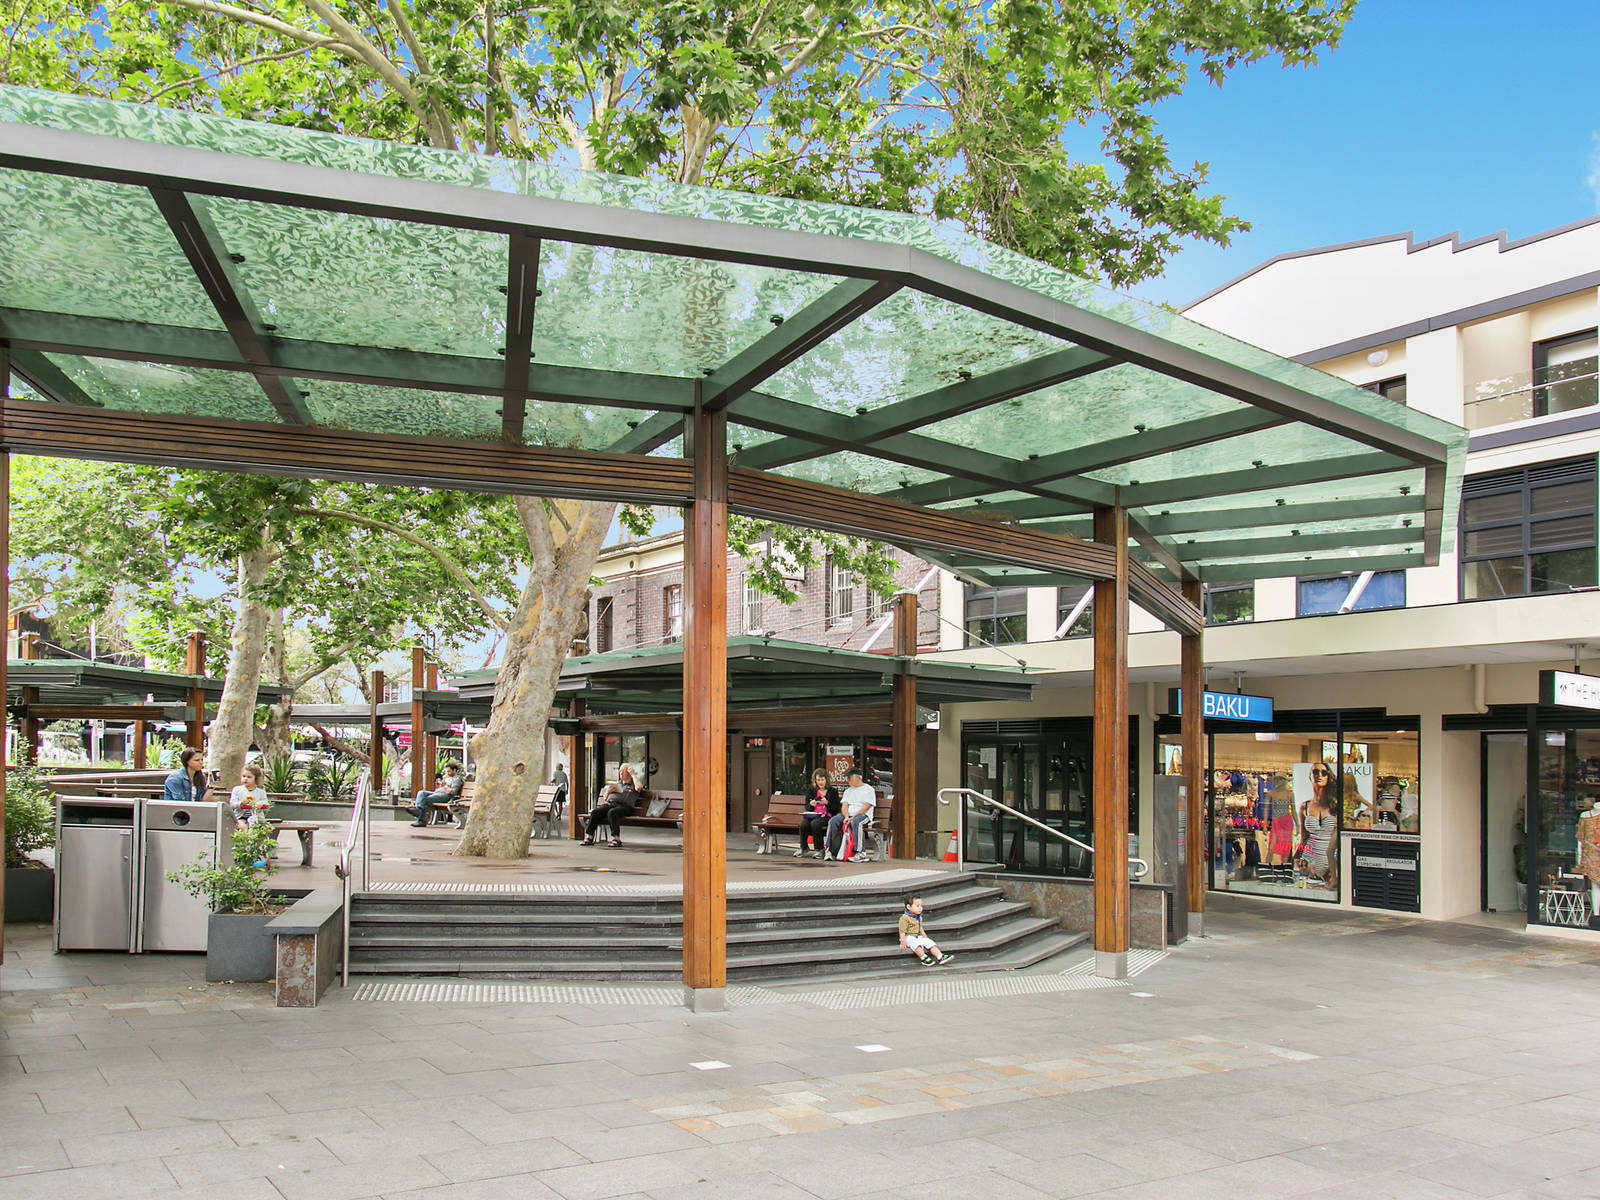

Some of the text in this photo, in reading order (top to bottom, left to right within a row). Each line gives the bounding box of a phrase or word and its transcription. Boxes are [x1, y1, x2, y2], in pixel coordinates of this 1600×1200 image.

[1569, 682, 1589, 701] THE
[1204, 694, 1250, 718] BAKU
[754, 738, 763, 746] 10
